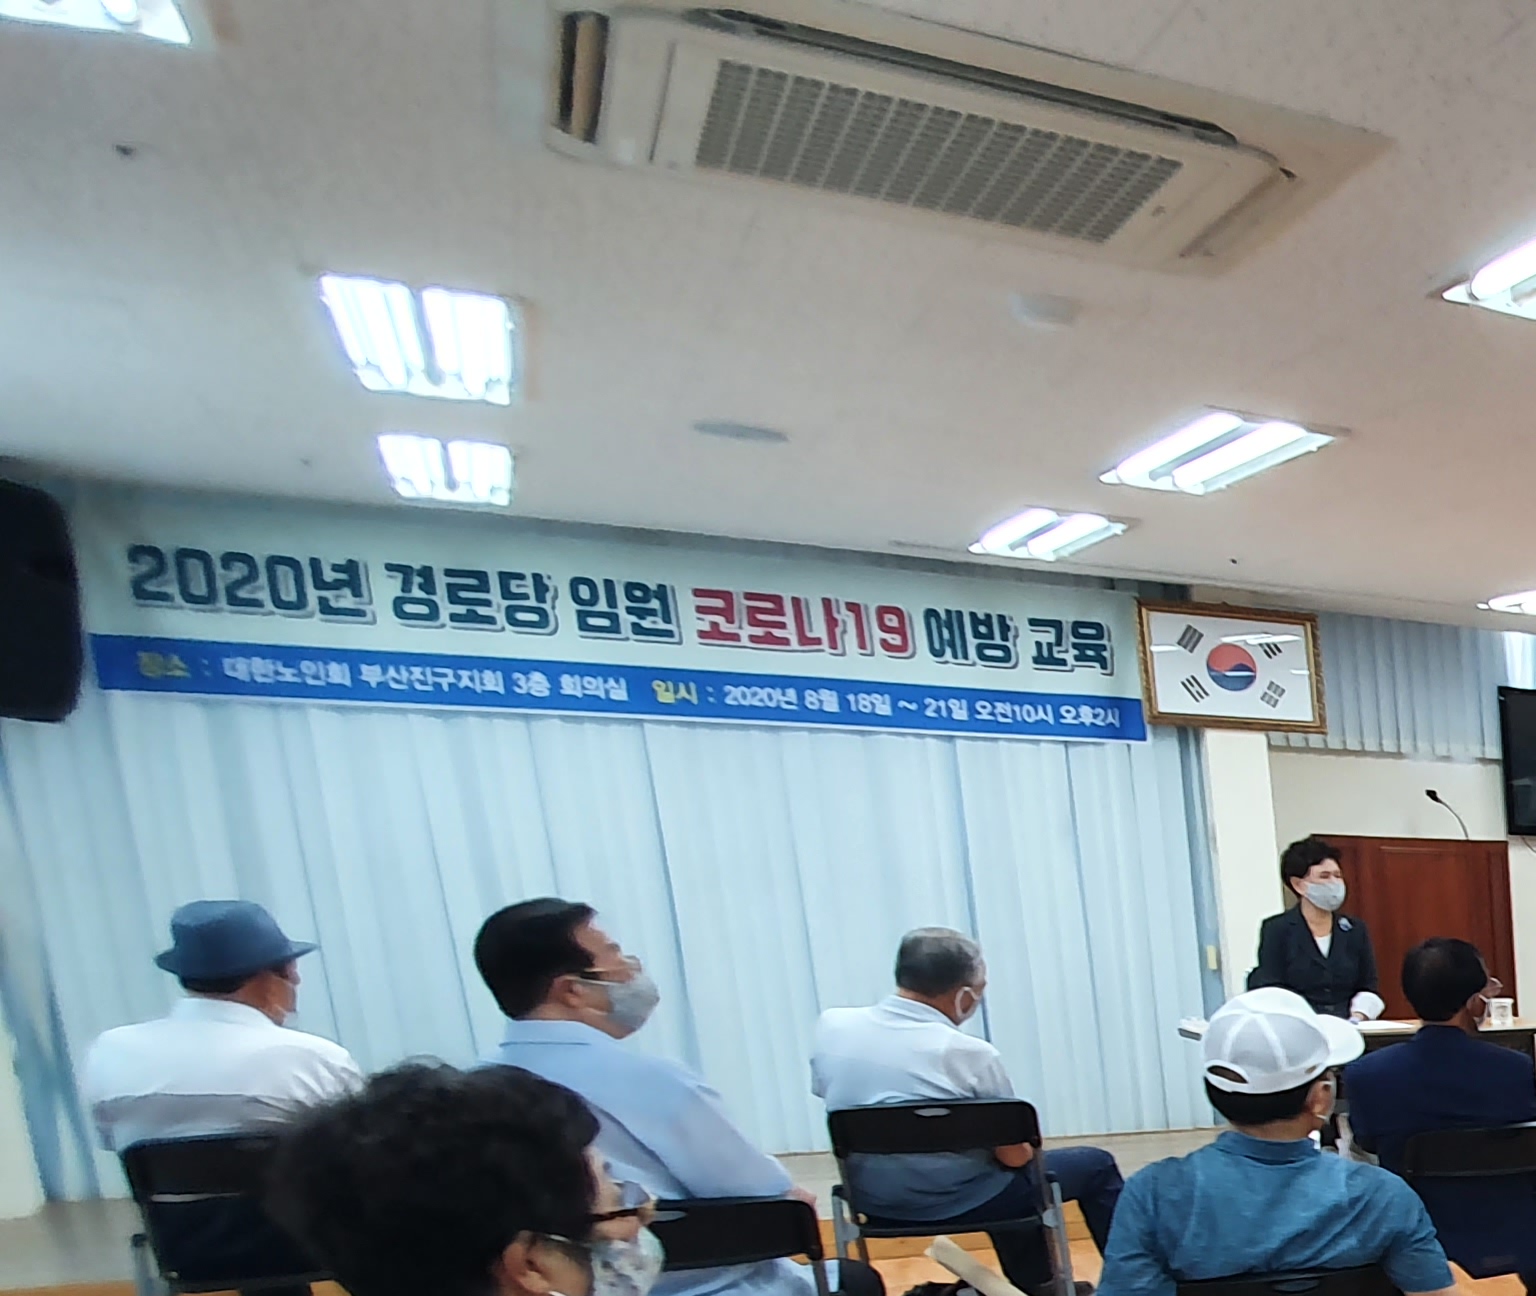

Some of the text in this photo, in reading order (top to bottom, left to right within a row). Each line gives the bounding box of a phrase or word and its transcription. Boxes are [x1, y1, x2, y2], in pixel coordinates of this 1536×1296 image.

[127, 544, 1111, 672] 2020년 경로당 임원 코로나19 예방 교육
[359, 663, 503, 695] 부산진구지회
[512, 670, 550, 696] 3층
[559, 673, 628, 701] 회의실
[652, 678, 698, 704] 일시
[723, 684, 798, 710] 2020년
[805, 688, 840, 713] 8월
[848, 691, 892, 716] 18일
[924, 697, 968, 721] 21일
[974, 700, 1055, 726] 오전10시
